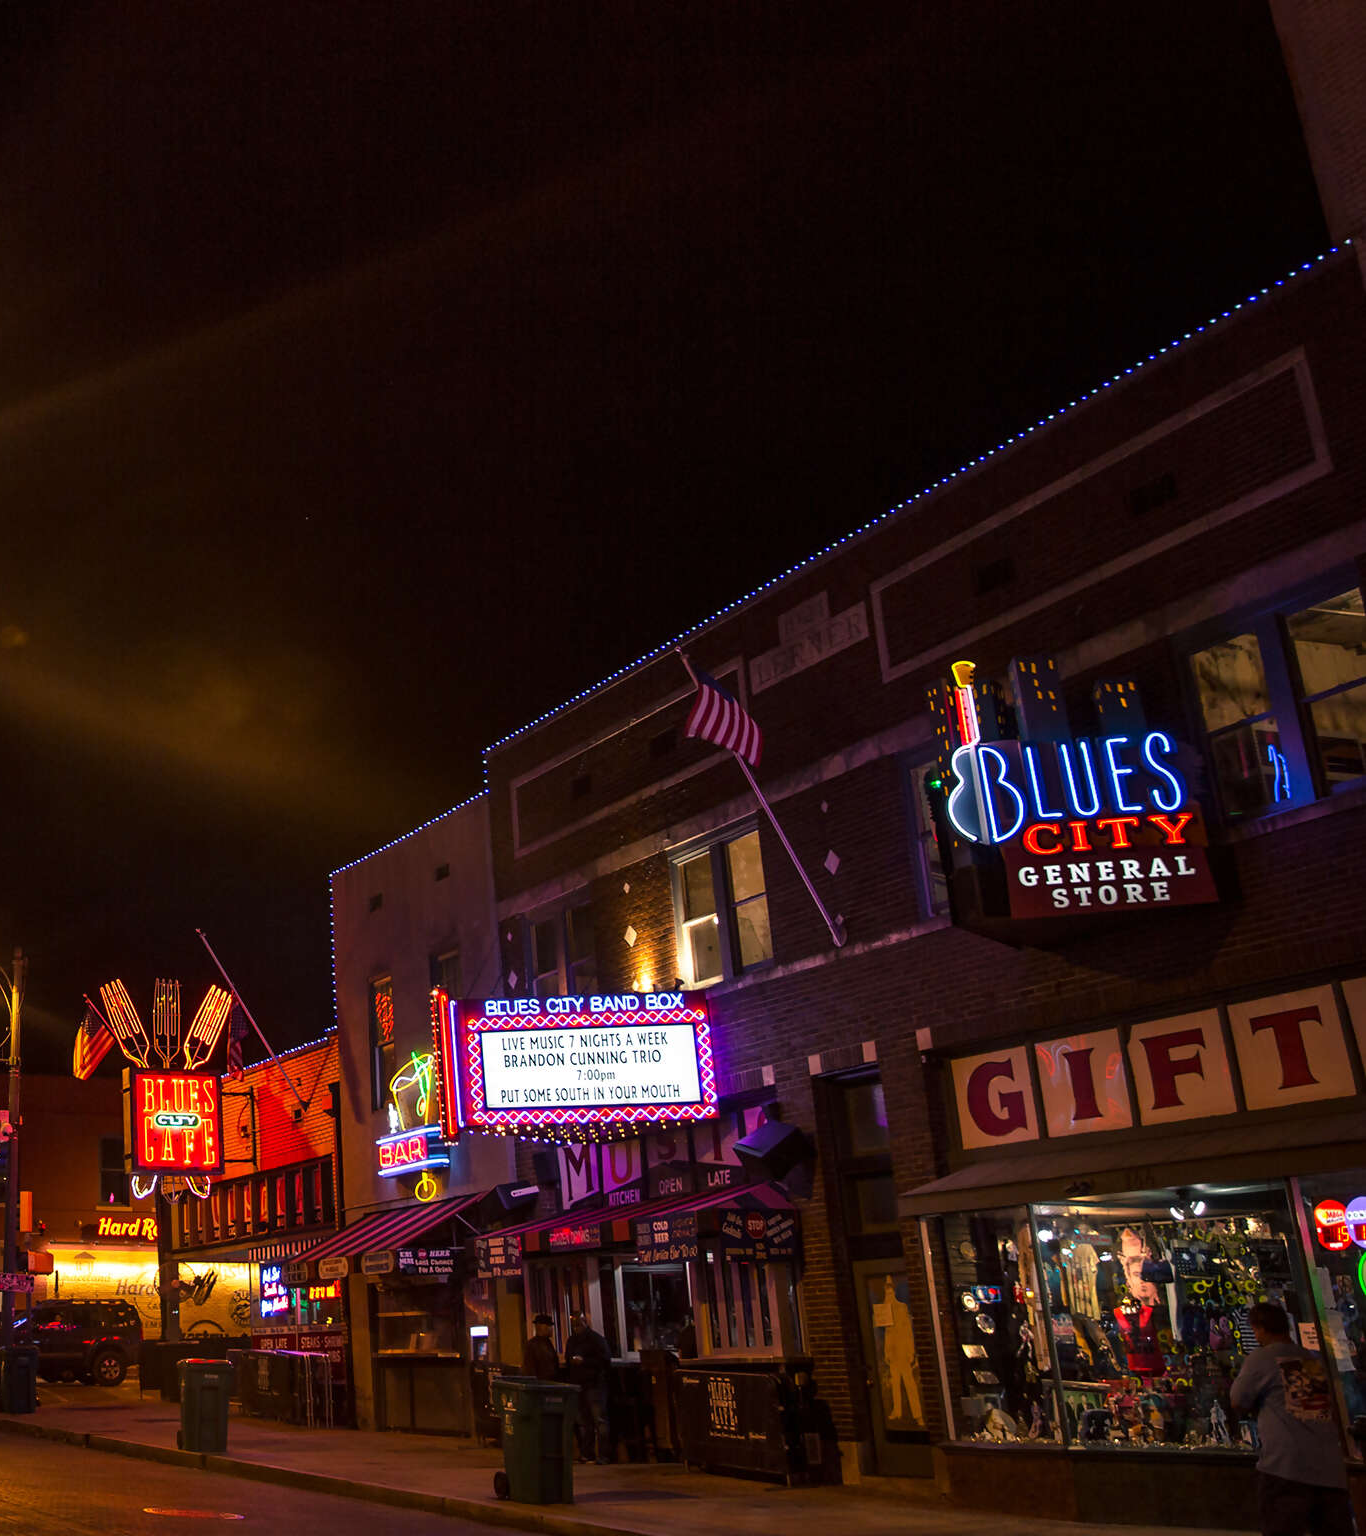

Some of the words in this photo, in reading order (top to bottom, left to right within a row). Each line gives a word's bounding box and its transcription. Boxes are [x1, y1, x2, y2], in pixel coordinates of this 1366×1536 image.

[976, 730, 1184, 844] BLUES
[1022, 812, 1193, 855] CITY
[1018, 855, 1196, 886] GENERAL
[1052, 881, 1170, 909] STORE
[484, 998, 541, 1016] BLUES
[546, 996, 584, 1014] CITY
[590, 995, 640, 1012] BAND
[645, 993, 685, 1010] BOX
[502, 1038, 525, 1051] LIVE
[530, 1036, 564, 1050] MUSIC
[569, 1035, 575, 1048] 7
[580, 1033, 621, 1048] NIGHTS
[626, 1033, 633, 1045] A
[637, 1032, 669, 1046] WEEK
[504, 1053, 565, 1068] BRANDON
[569, 1051, 628, 1065] CUNNING
[632, 1049, 662, 1063] TRIO
[966, 1005, 1322, 1137] GIFT
[577, 1069, 616, 1082] 7:00pm
[143, 1078, 215, 1113] BLUES
[501, 1089, 520, 1104] PUT
[524, 1088, 552, 1103] SOME
[555, 1087, 589, 1101] SOUTH
[593, 1086, 604, 1100] IN
[610, 1085, 637, 1100] YOUR
[641, 1084, 681, 1099] MOUTH
[157, 1115, 196, 1125] CITY
[143, 1116, 215, 1165] CAFE
[379, 1137, 427, 1167] BAR
[609, 1188, 641, 1208] KITCHEN
[659, 1177, 683, 1196] OPEN
[707, 1169, 731, 1187] LATE
[98, 1217, 141, 1237] Hard
[142, 1217, 158, 1241] Ro
[653, 1220, 669, 1232] COLD
